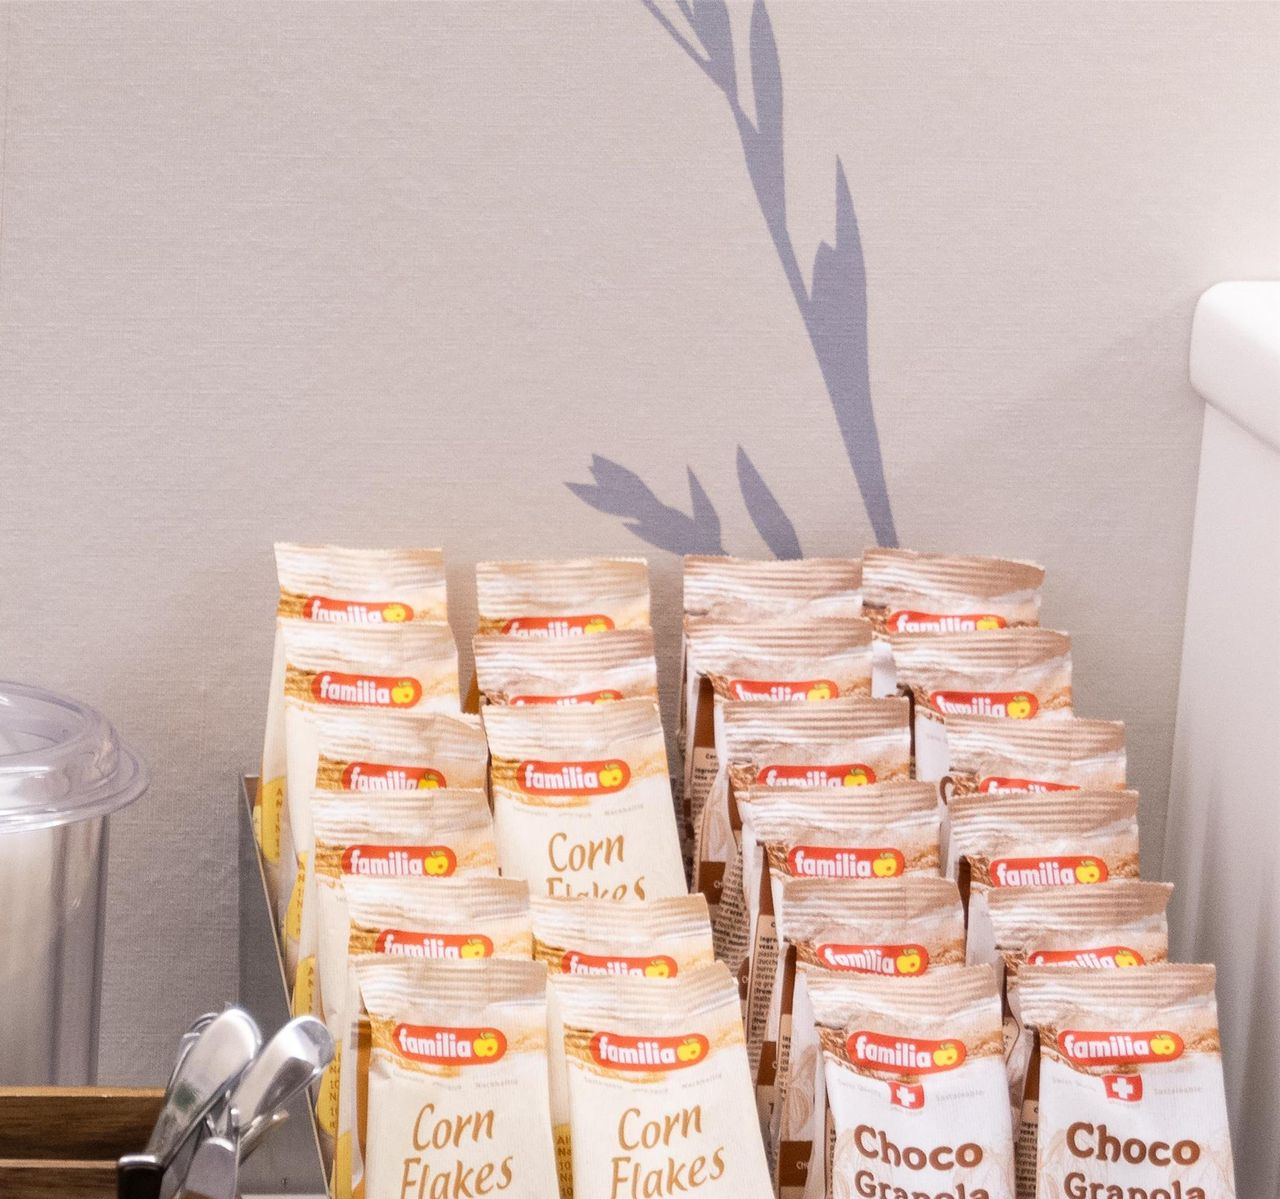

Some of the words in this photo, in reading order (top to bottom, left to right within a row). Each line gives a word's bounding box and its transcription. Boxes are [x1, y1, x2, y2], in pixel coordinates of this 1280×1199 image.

[896, 614, 976, 632] familia
[319, 675, 390, 704] familia
[350, 767, 418, 790] familia
[525, 764, 598, 789] familia
[350, 849, 423, 876] familia
[547, 832, 625, 873] Corn
[794, 850, 871, 877] familia
[997, 862, 1074, 886] familia
[384, 934, 459, 959] familia
[824, 948, 894, 974] familia
[399, 1028, 472, 1058] familia
[598, 1036, 676, 1065] familia
[855, 1035, 932, 1068] familia
[1063, 1034, 1149, 1058] familia
[413, 1103, 495, 1152] Corn
[618, 1104, 702, 1152] Corn
[854, 1124, 984, 1171] Choco
[1065, 1121, 1201, 1167] Choco
